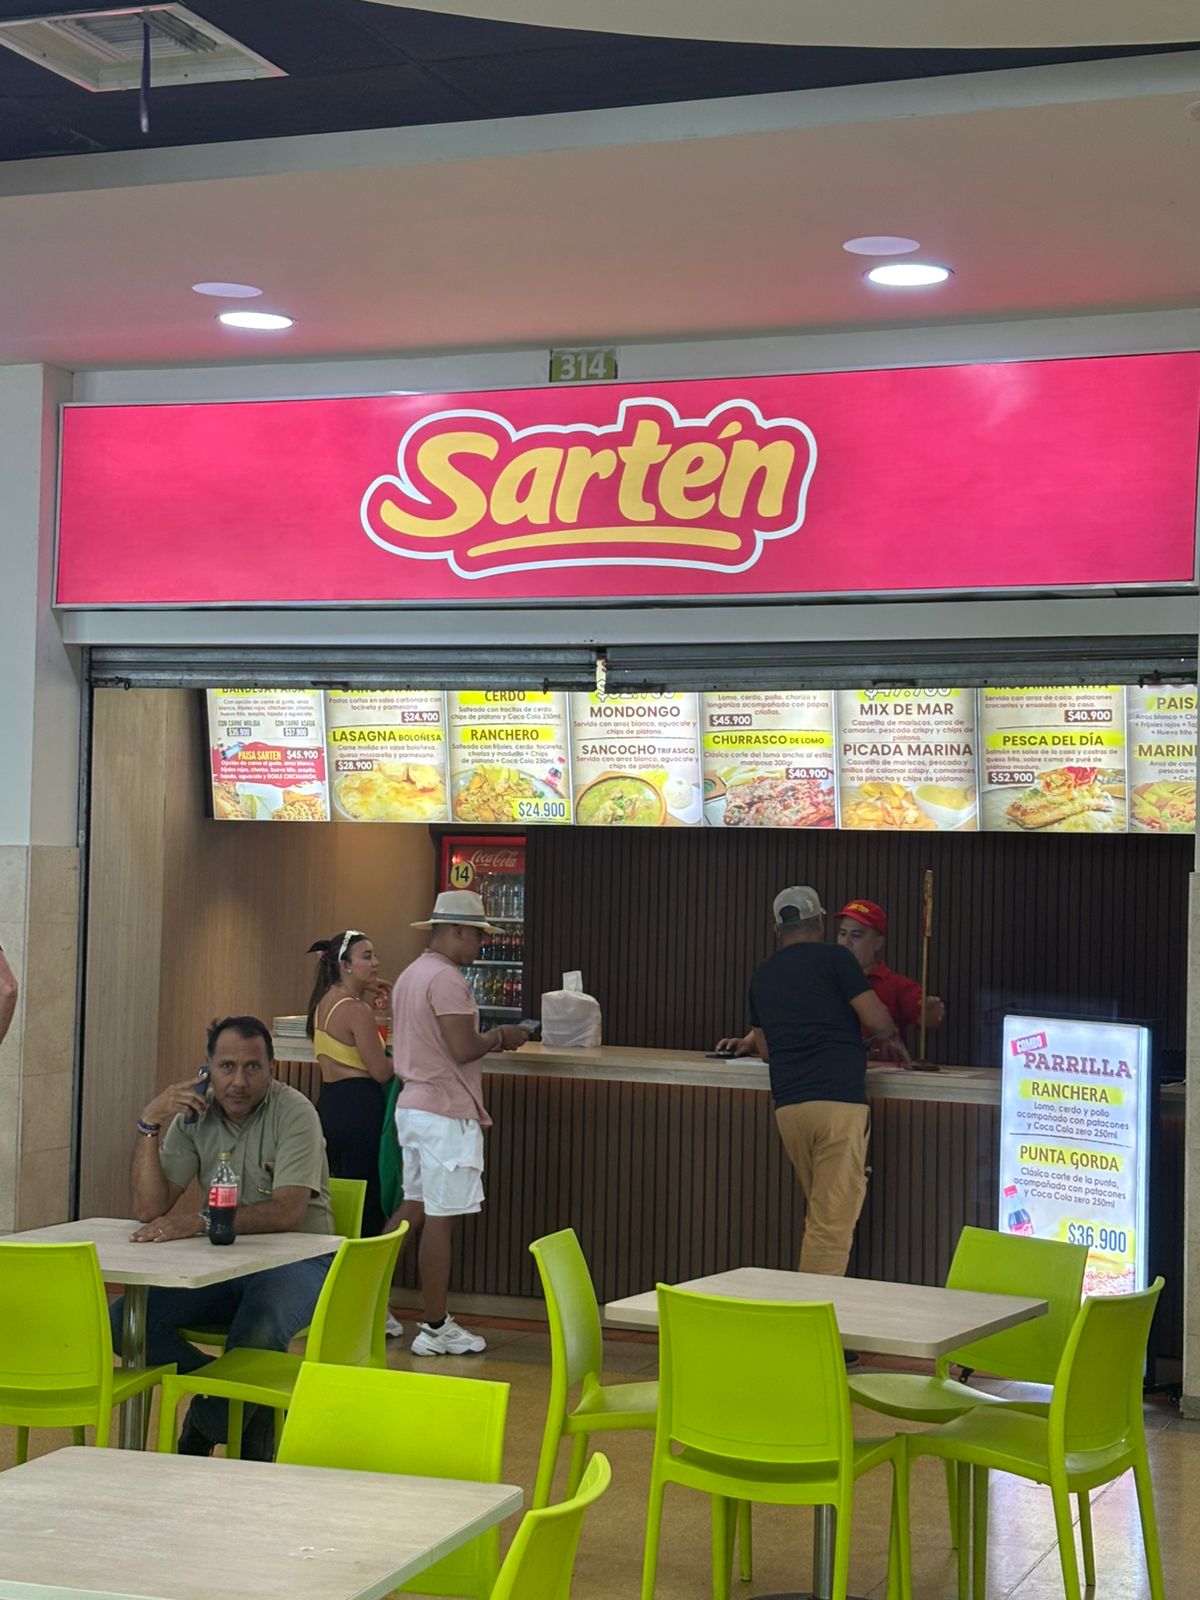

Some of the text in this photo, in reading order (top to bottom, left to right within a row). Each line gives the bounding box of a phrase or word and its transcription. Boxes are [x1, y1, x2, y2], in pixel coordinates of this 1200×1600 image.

[560, 352, 607, 381] 314
[380, 419, 795, 537] Sartén
[485, 691, 526, 701] CERDO
[860, 703, 953, 715] MIX DE MAR
[1157, 697, 1197, 709] PAIS
[404, 713, 438, 721] $24.900
[590, 706, 680, 717] MONDONGO
[1068, 711, 1110, 721] $40.900
[712, 716, 750, 725] $45.900
[333, 731, 396, 742] LASAGNA
[471, 730, 539, 740] RANCHERO
[712, 735, 787, 744] CHURRASCO
[1003, 733, 1103, 745] PESCA DEL DÍA
[287, 750, 318, 760] $45.900
[582, 745, 656, 755] SANCOCHO
[843, 744, 973, 756] PICADA MARINA
[338, 761, 372, 770] $28.900
[788, 769, 827, 779] $40.900
[991, 773, 1033, 782] $52.900
[519, 802, 565, 817] $24.900
[455, 866, 469, 881] 14
[1024, 1052, 1132, 1079] PARRILLA
[1032, 1081, 1109, 1103] RANCHERA
[1059, 1105, 1081, 1114] cerdo
[1084, 1107, 1088, 1115] y
[1090, 1108, 1109, 1118] pollo
[1087, 1117, 1128, 1130] patacones
[1027, 1121, 1118, 1139] y Coca Cola zero 250ml
[1020, 1145, 1119, 1172] PUNTA GORDA
[1051, 1172, 1070, 1181] corte
[1073, 1174, 1083, 1183] de
[1085, 1176, 1092, 1184] la
[1024, 1188, 1115, 1208] y Coca Cola zero 250ml
[1068, 1184, 1083, 1193] con
[1085, 1186, 1126, 1200] patacones
[1068, 1222, 1127, 1253] $36.900
